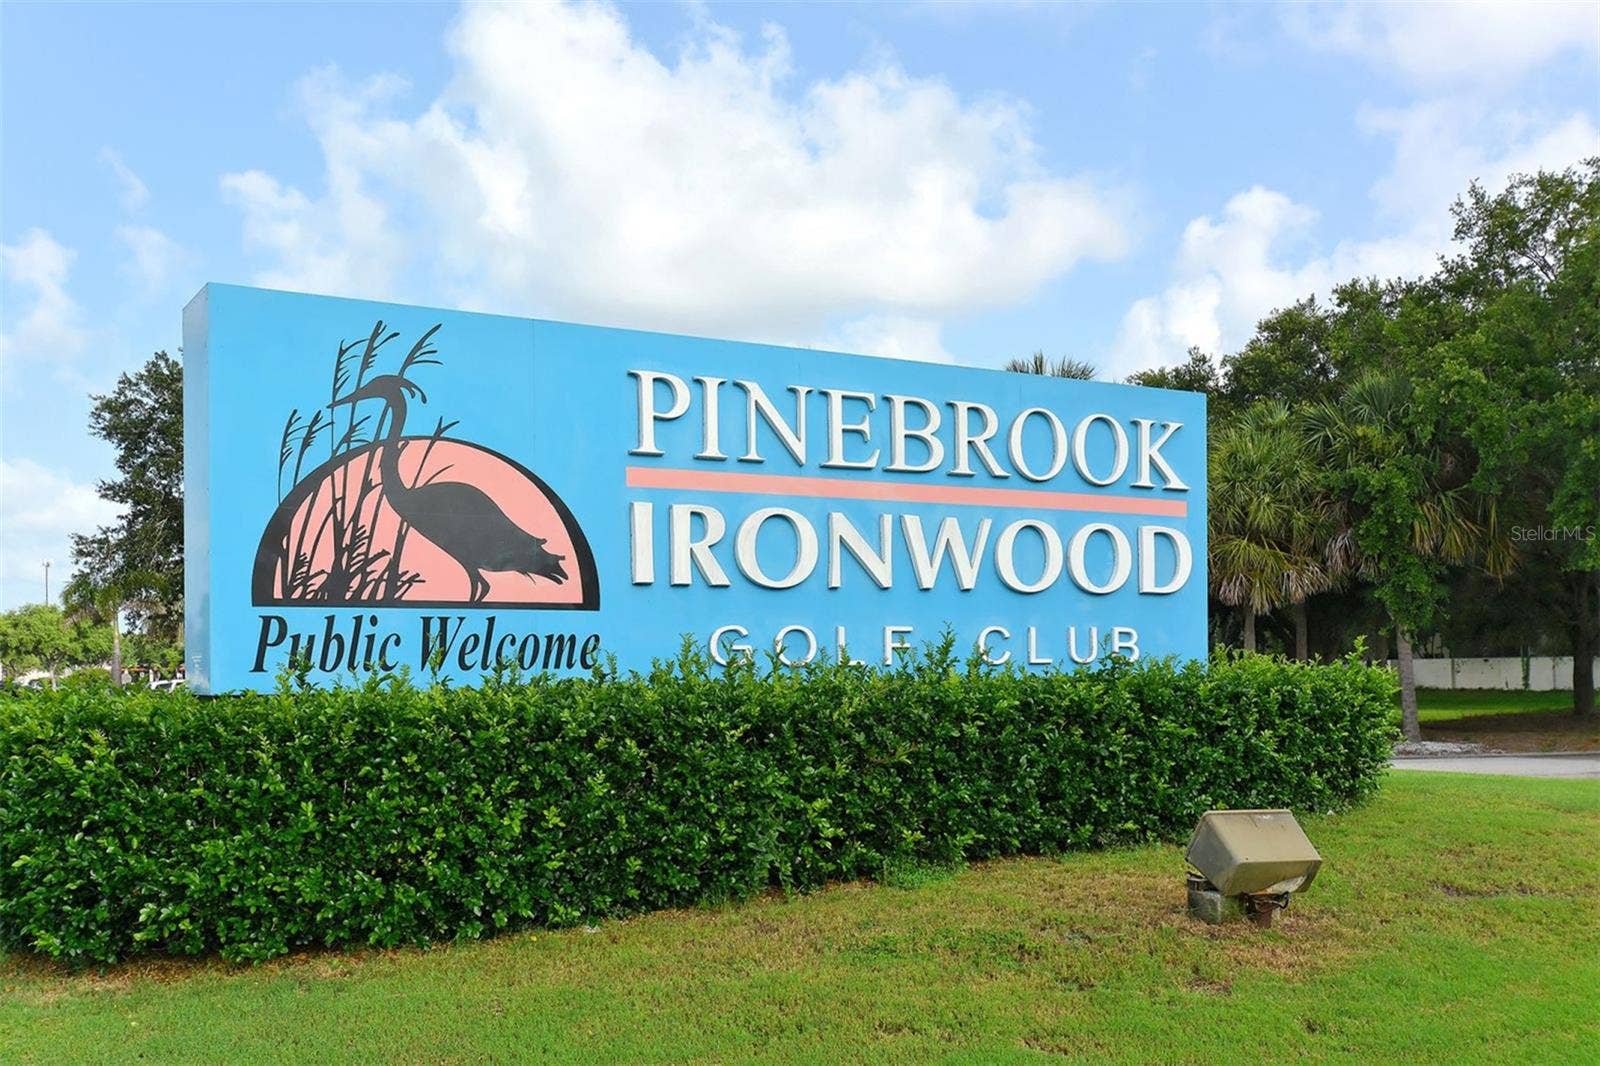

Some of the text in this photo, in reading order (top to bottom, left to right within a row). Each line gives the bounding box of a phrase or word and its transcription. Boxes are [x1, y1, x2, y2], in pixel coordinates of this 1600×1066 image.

[627, 369, 1191, 491] PINEBROOK
[629, 501, 1193, 595] IRONWOOD
[249, 614, 601, 673] Public Welcome
[709, 624, 1141, 669] GOLF CLUB
